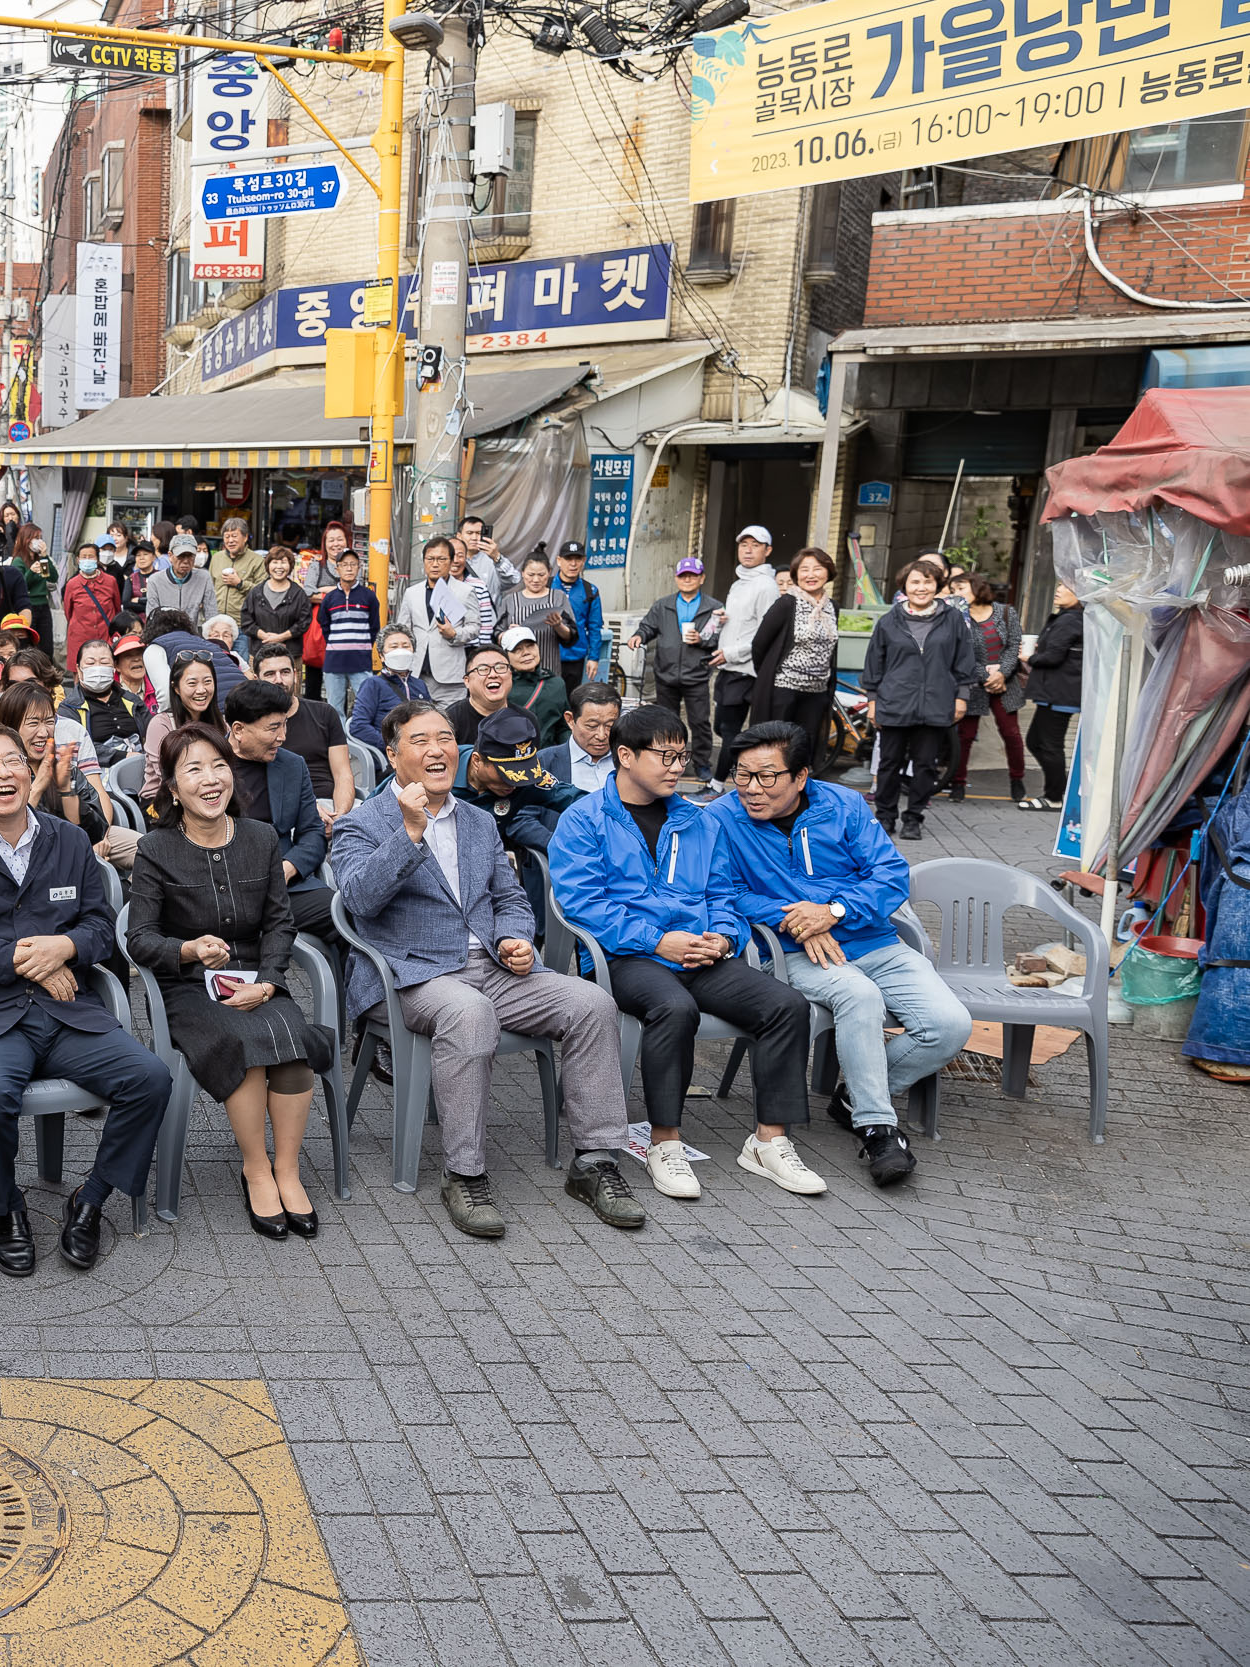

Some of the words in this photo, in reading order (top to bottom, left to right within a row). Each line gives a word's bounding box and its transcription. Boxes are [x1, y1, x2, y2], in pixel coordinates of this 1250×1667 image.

[91, 45, 131, 67] CCTV
[134, 48, 176, 74] 작동중
[756, 33, 853, 90] 능동로
[206, 54, 259, 152] 중앙
[755, 76, 855, 124] 골목시장
[752, 152, 791, 173] 2023.
[794, 128, 875, 167] 10.06.
[877, 130, 902, 151] (금)
[911, 81, 1105, 146] 16:00~19:00
[232, 171, 307, 193] 뚝섬로30길
[321, 181, 336, 193] 37
[206, 193, 218, 204] 33
[227, 191, 285, 204] Ttukseom-ro
[287, 187, 314, 200] 30-gil
[196, 266, 260, 277] 463-2384
[593, 459, 631, 476] 사원모집
